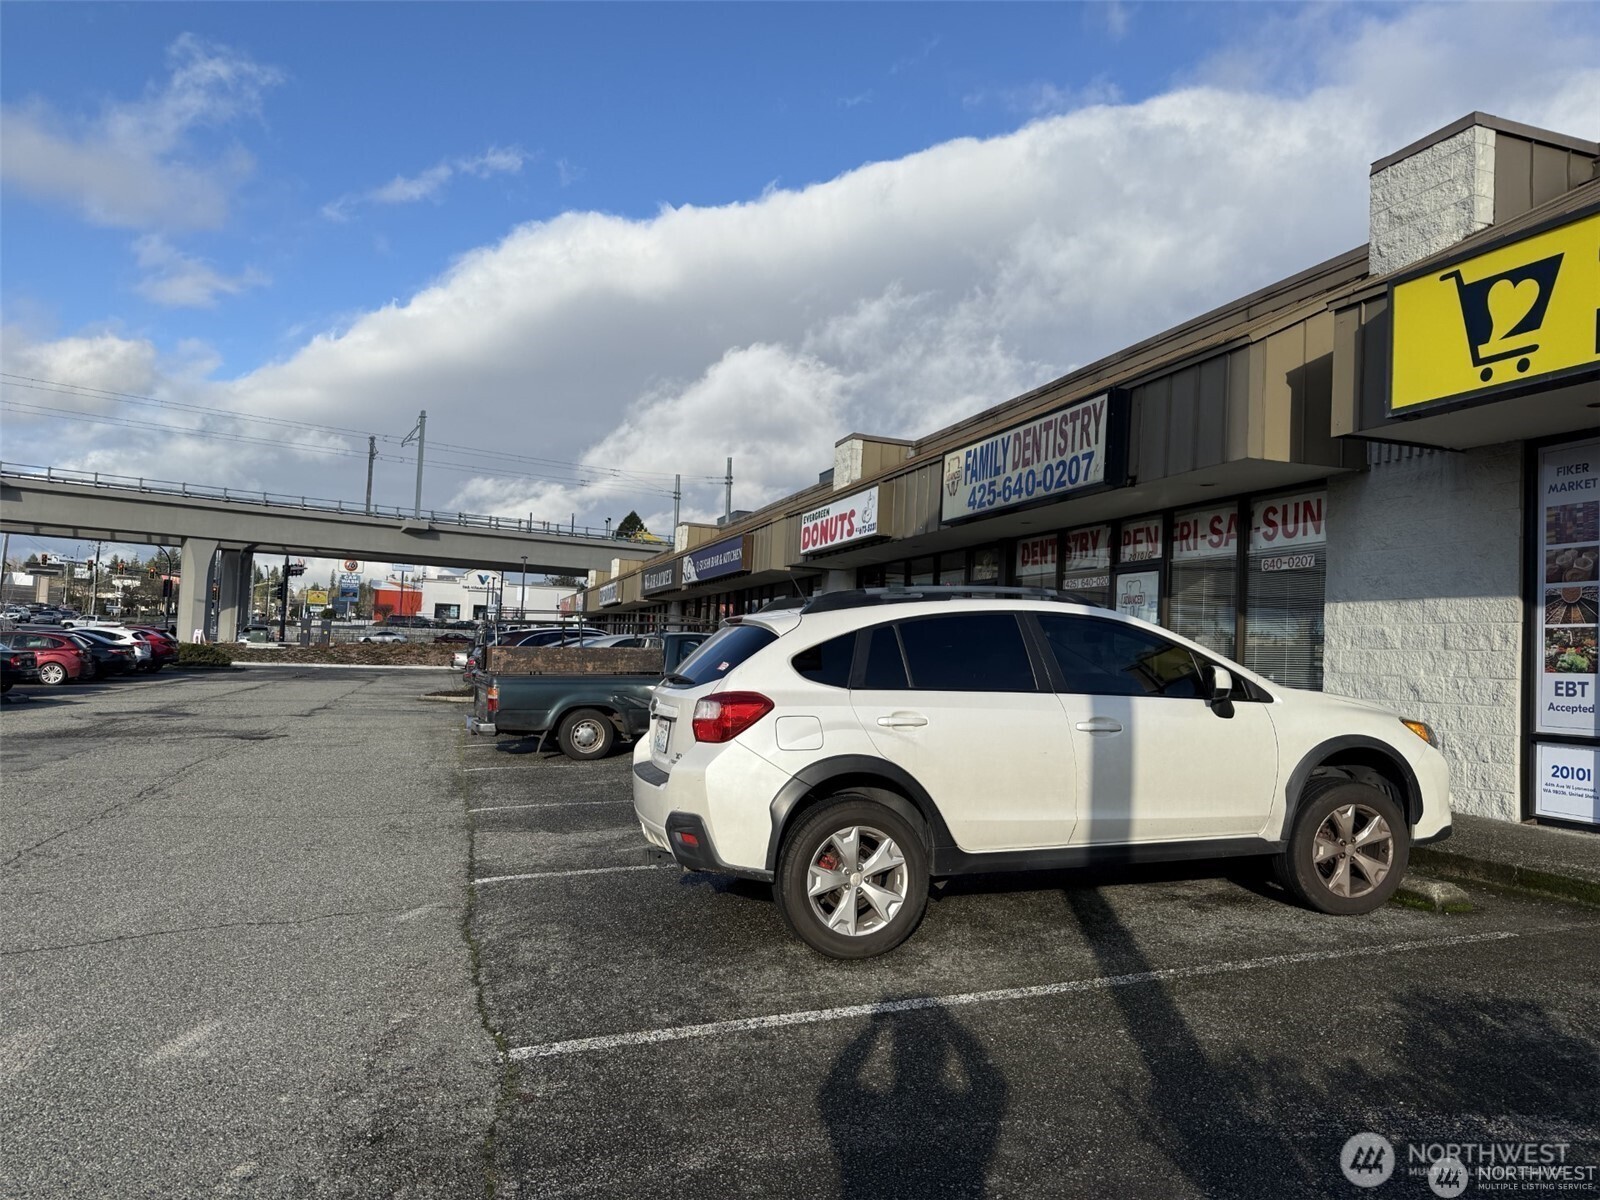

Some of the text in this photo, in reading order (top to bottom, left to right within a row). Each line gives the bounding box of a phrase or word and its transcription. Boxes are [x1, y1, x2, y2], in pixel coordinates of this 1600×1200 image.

[964, 400, 1105, 485] FAMILY DENTISTRY
[1556, 463, 1589, 477] FIKER
[968, 451, 1095, 510] 425-640-0207
[1548, 478, 1598, 494] MARKET
[803, 507, 830, 524] EVERGREEN
[802, 509, 856, 550] DONUTS
[723, 547, 743, 563] KITCHEN
[1263, 555, 1314, 571] 640-0207
[1554, 681, 1589, 697] EBT
[1547, 702, 1595, 714] Accepted
[1551, 765, 1591, 781] 20101
